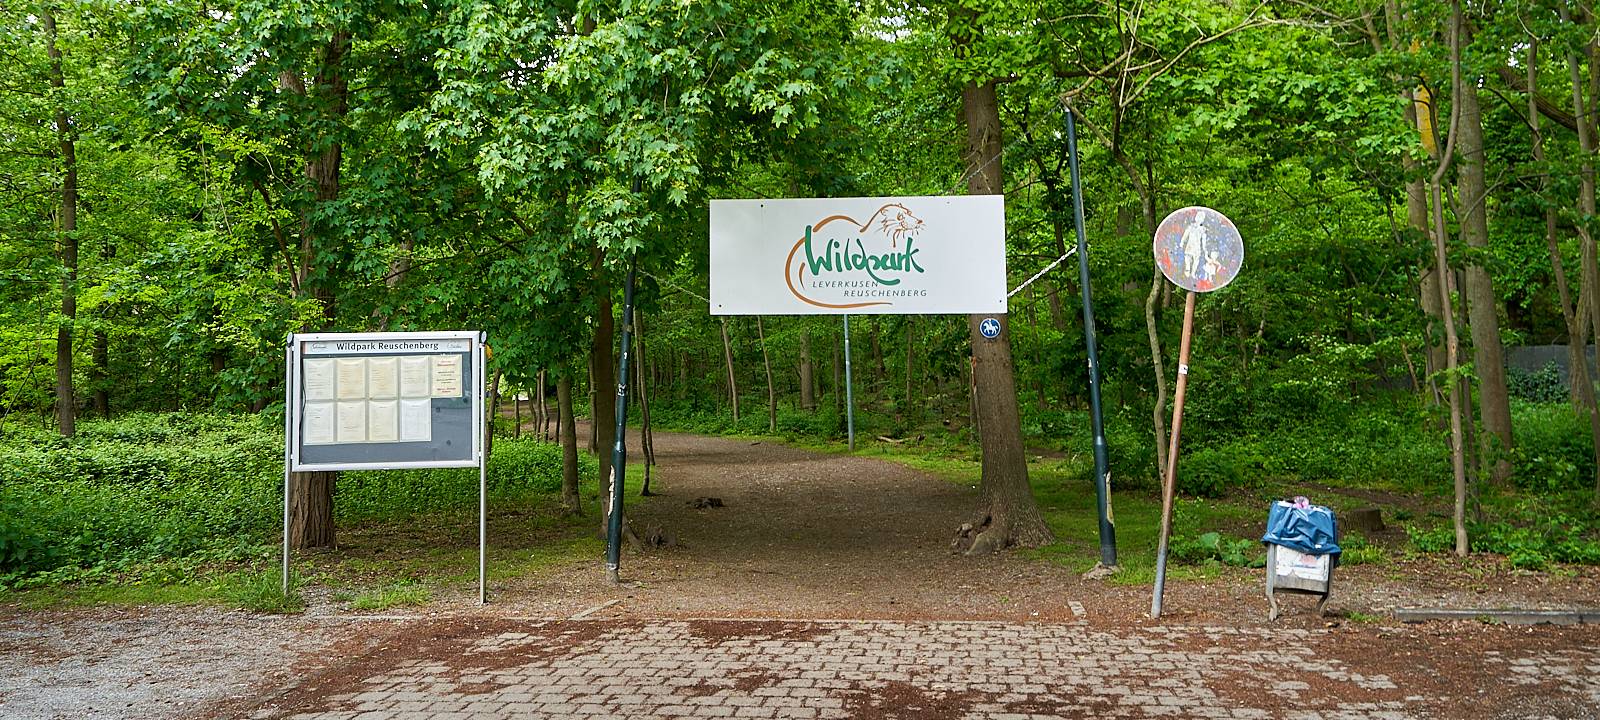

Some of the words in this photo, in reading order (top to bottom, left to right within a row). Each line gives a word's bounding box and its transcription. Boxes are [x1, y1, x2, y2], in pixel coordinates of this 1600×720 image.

[805, 225, 924, 285] Wildpark
[812, 280, 879, 288] LEVERKUSEN
[844, 289, 927, 297] REUSCHENBERG
[336, 342, 376, 351] Wildpark
[378, 341, 439, 350] Reuschenberg
